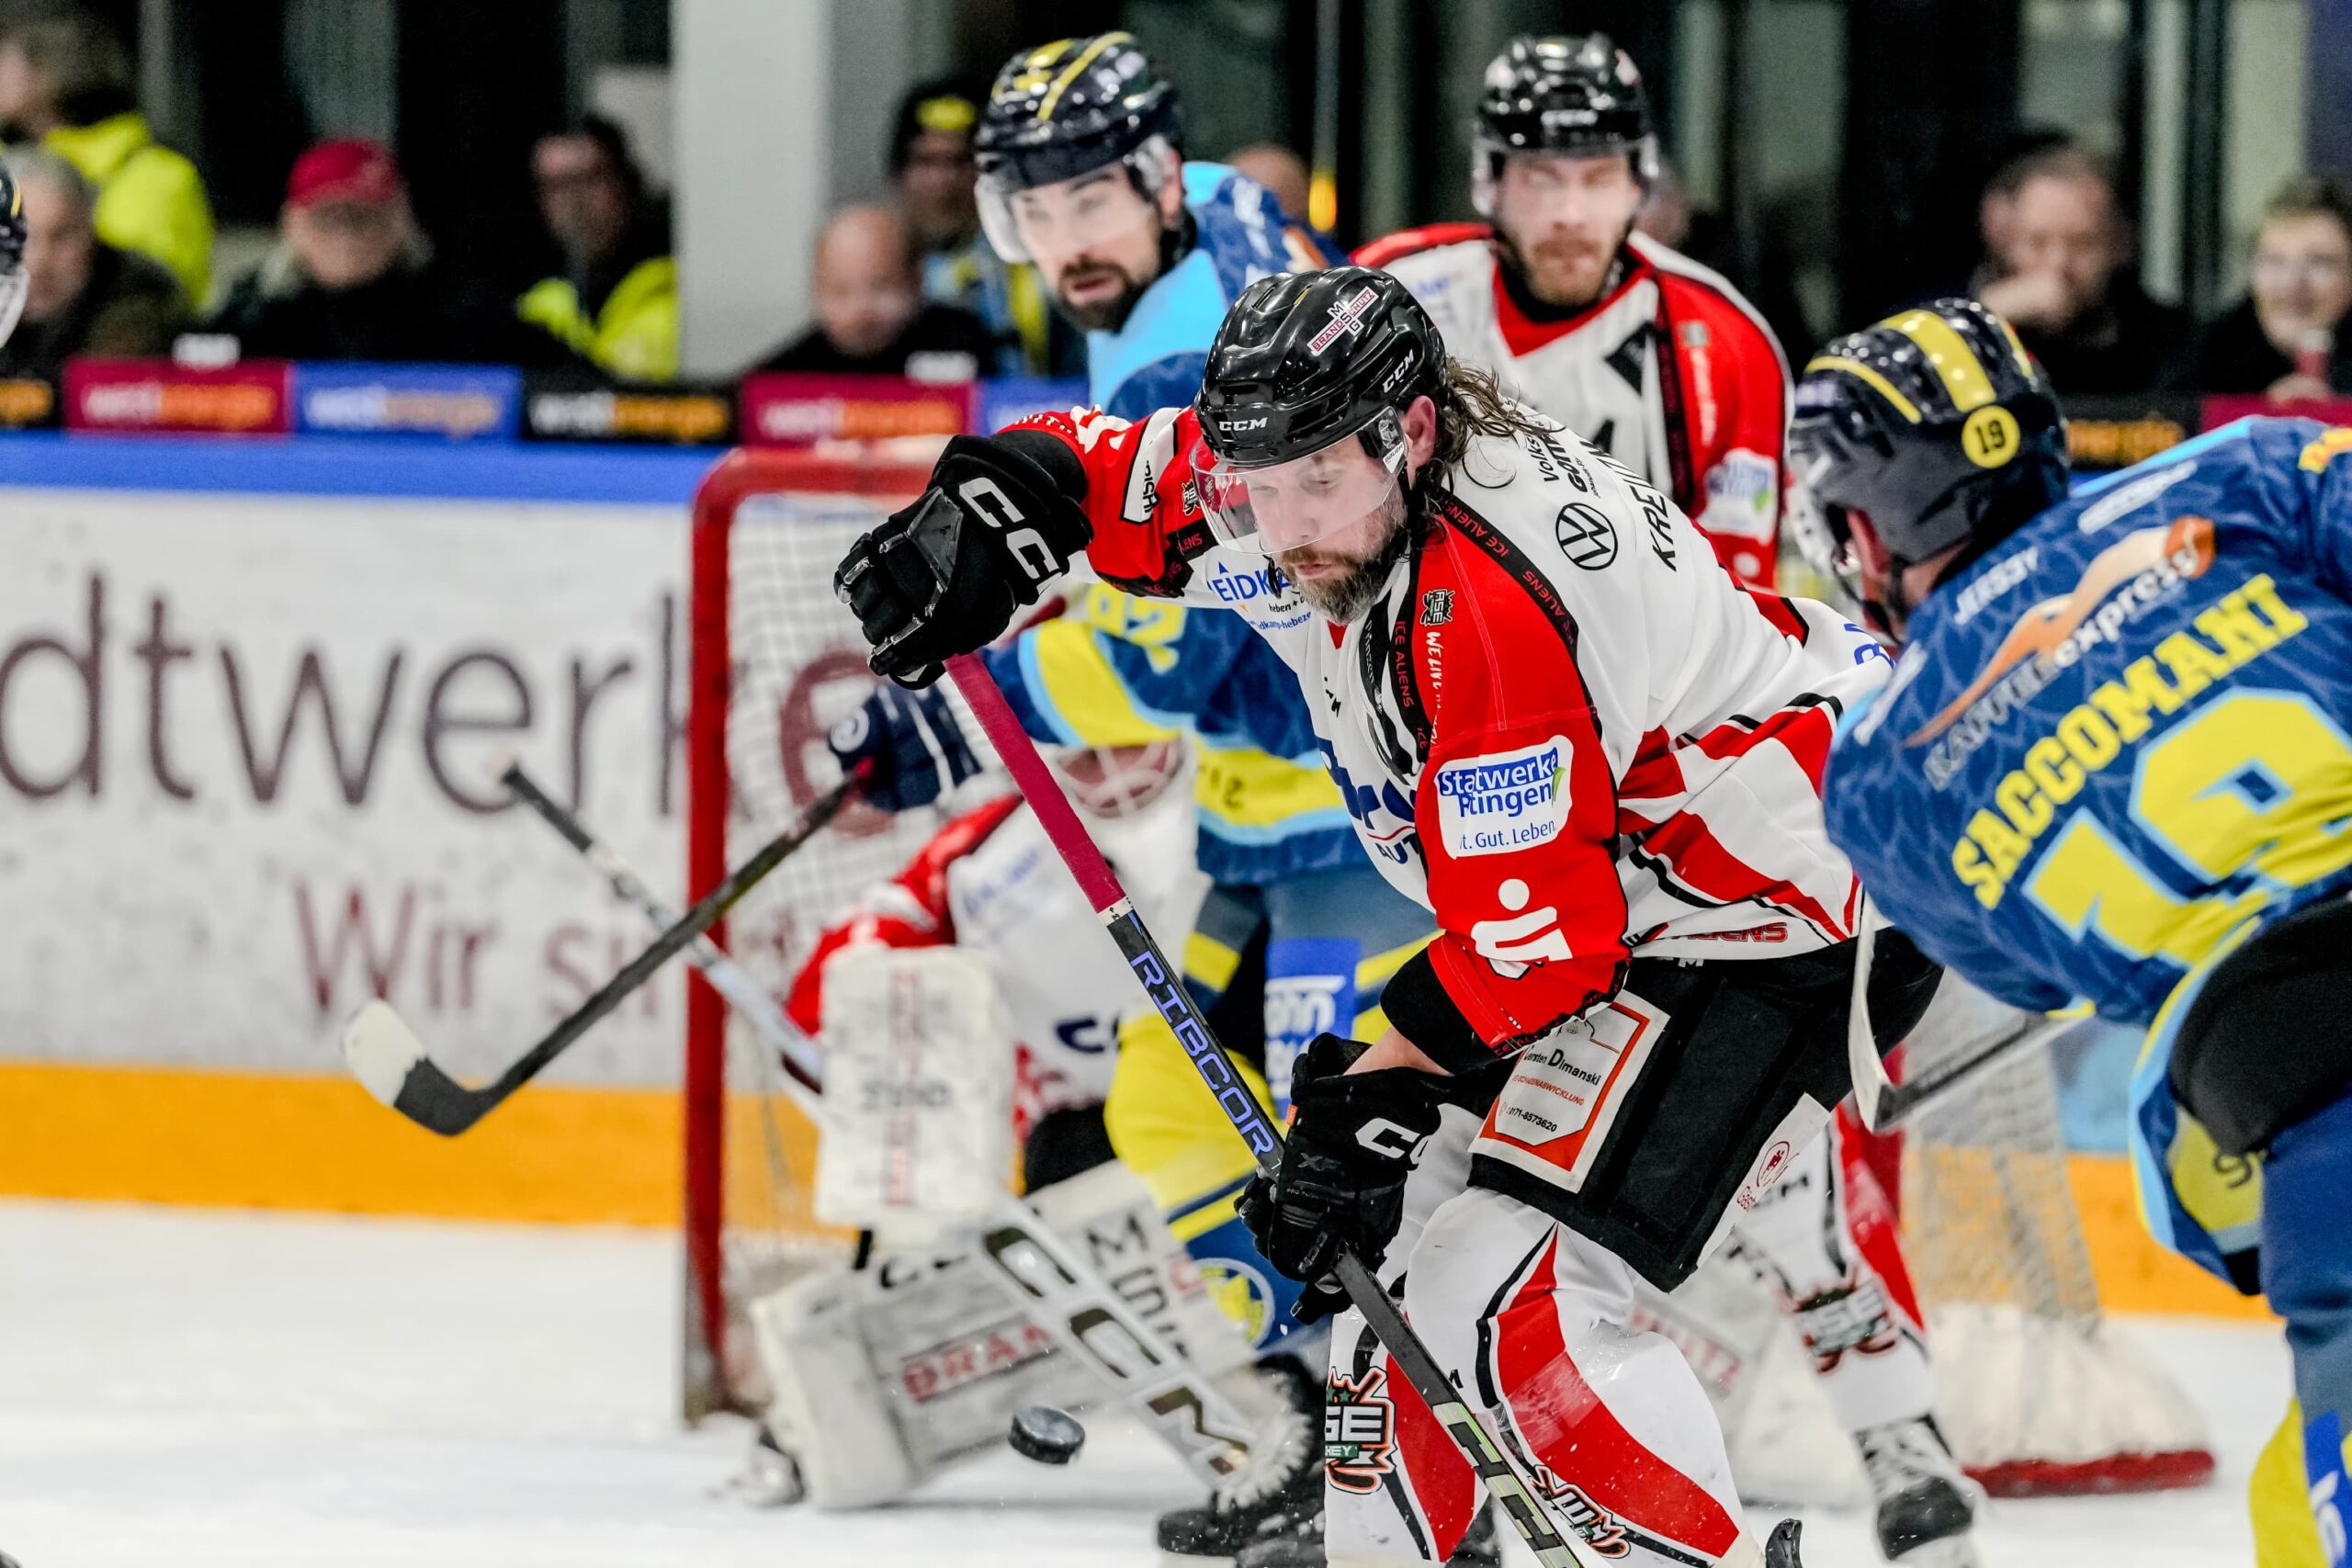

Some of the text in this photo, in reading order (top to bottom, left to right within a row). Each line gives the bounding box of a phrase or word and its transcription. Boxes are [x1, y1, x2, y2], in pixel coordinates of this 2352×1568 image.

[1382, 348, 1415, 393] CCM
[1218, 417, 1268, 432] CCM
[1975, 419, 2006, 454] 19
[958, 476, 1064, 598] CC
[1394, 619, 1416, 708] ICE ALIENS
[1951, 573, 2308, 910] SACCOMANI
[1475, 830, 1510, 849] Gut.
[292, 880, 496, 1018] Wir
[1130, 949, 1275, 1156] RIBCOR
[1548, 1048, 1602, 1087] Dimanski
